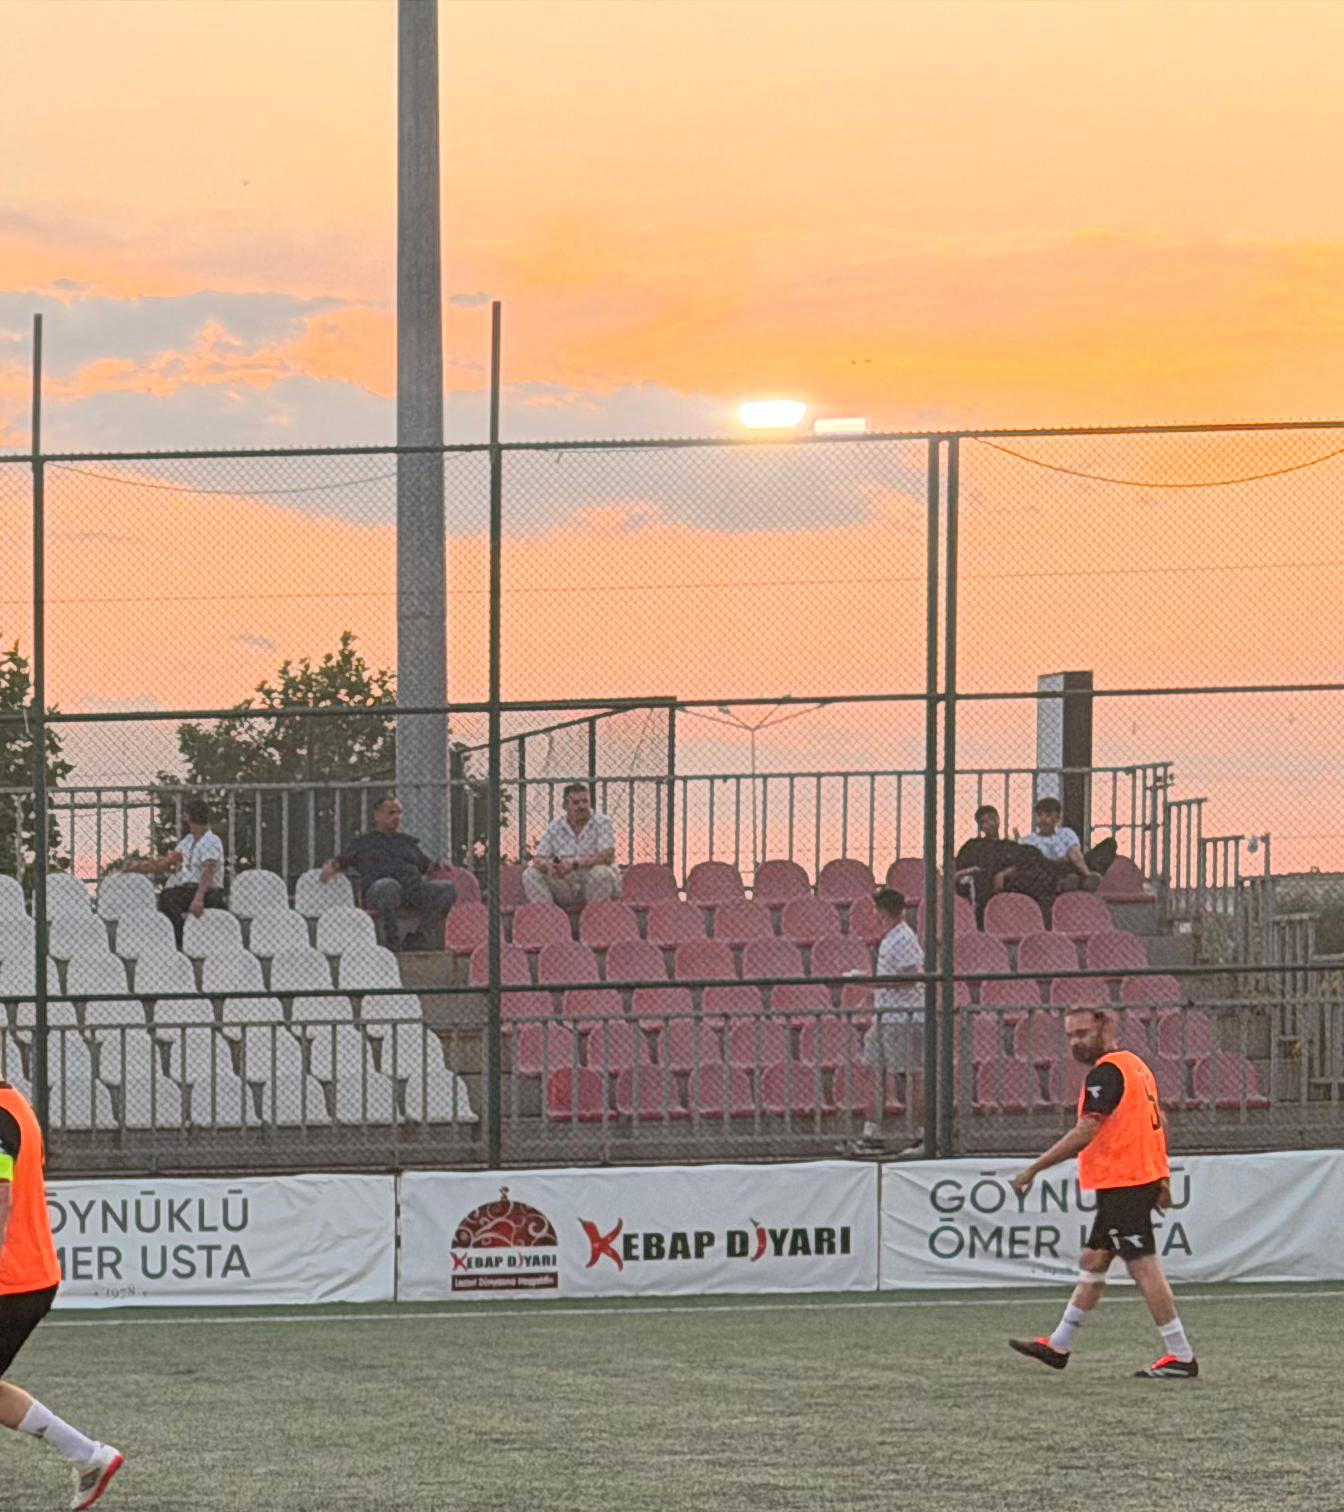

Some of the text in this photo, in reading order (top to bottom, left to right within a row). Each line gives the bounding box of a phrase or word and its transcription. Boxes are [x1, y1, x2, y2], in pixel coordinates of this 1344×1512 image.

[577, 1217, 716, 1272] KEBAP
[57, 1244, 251, 1281] ER USTA
[450, 1252, 504, 1272] KEBAP
[105, 1285, 136, 1298] 1978
